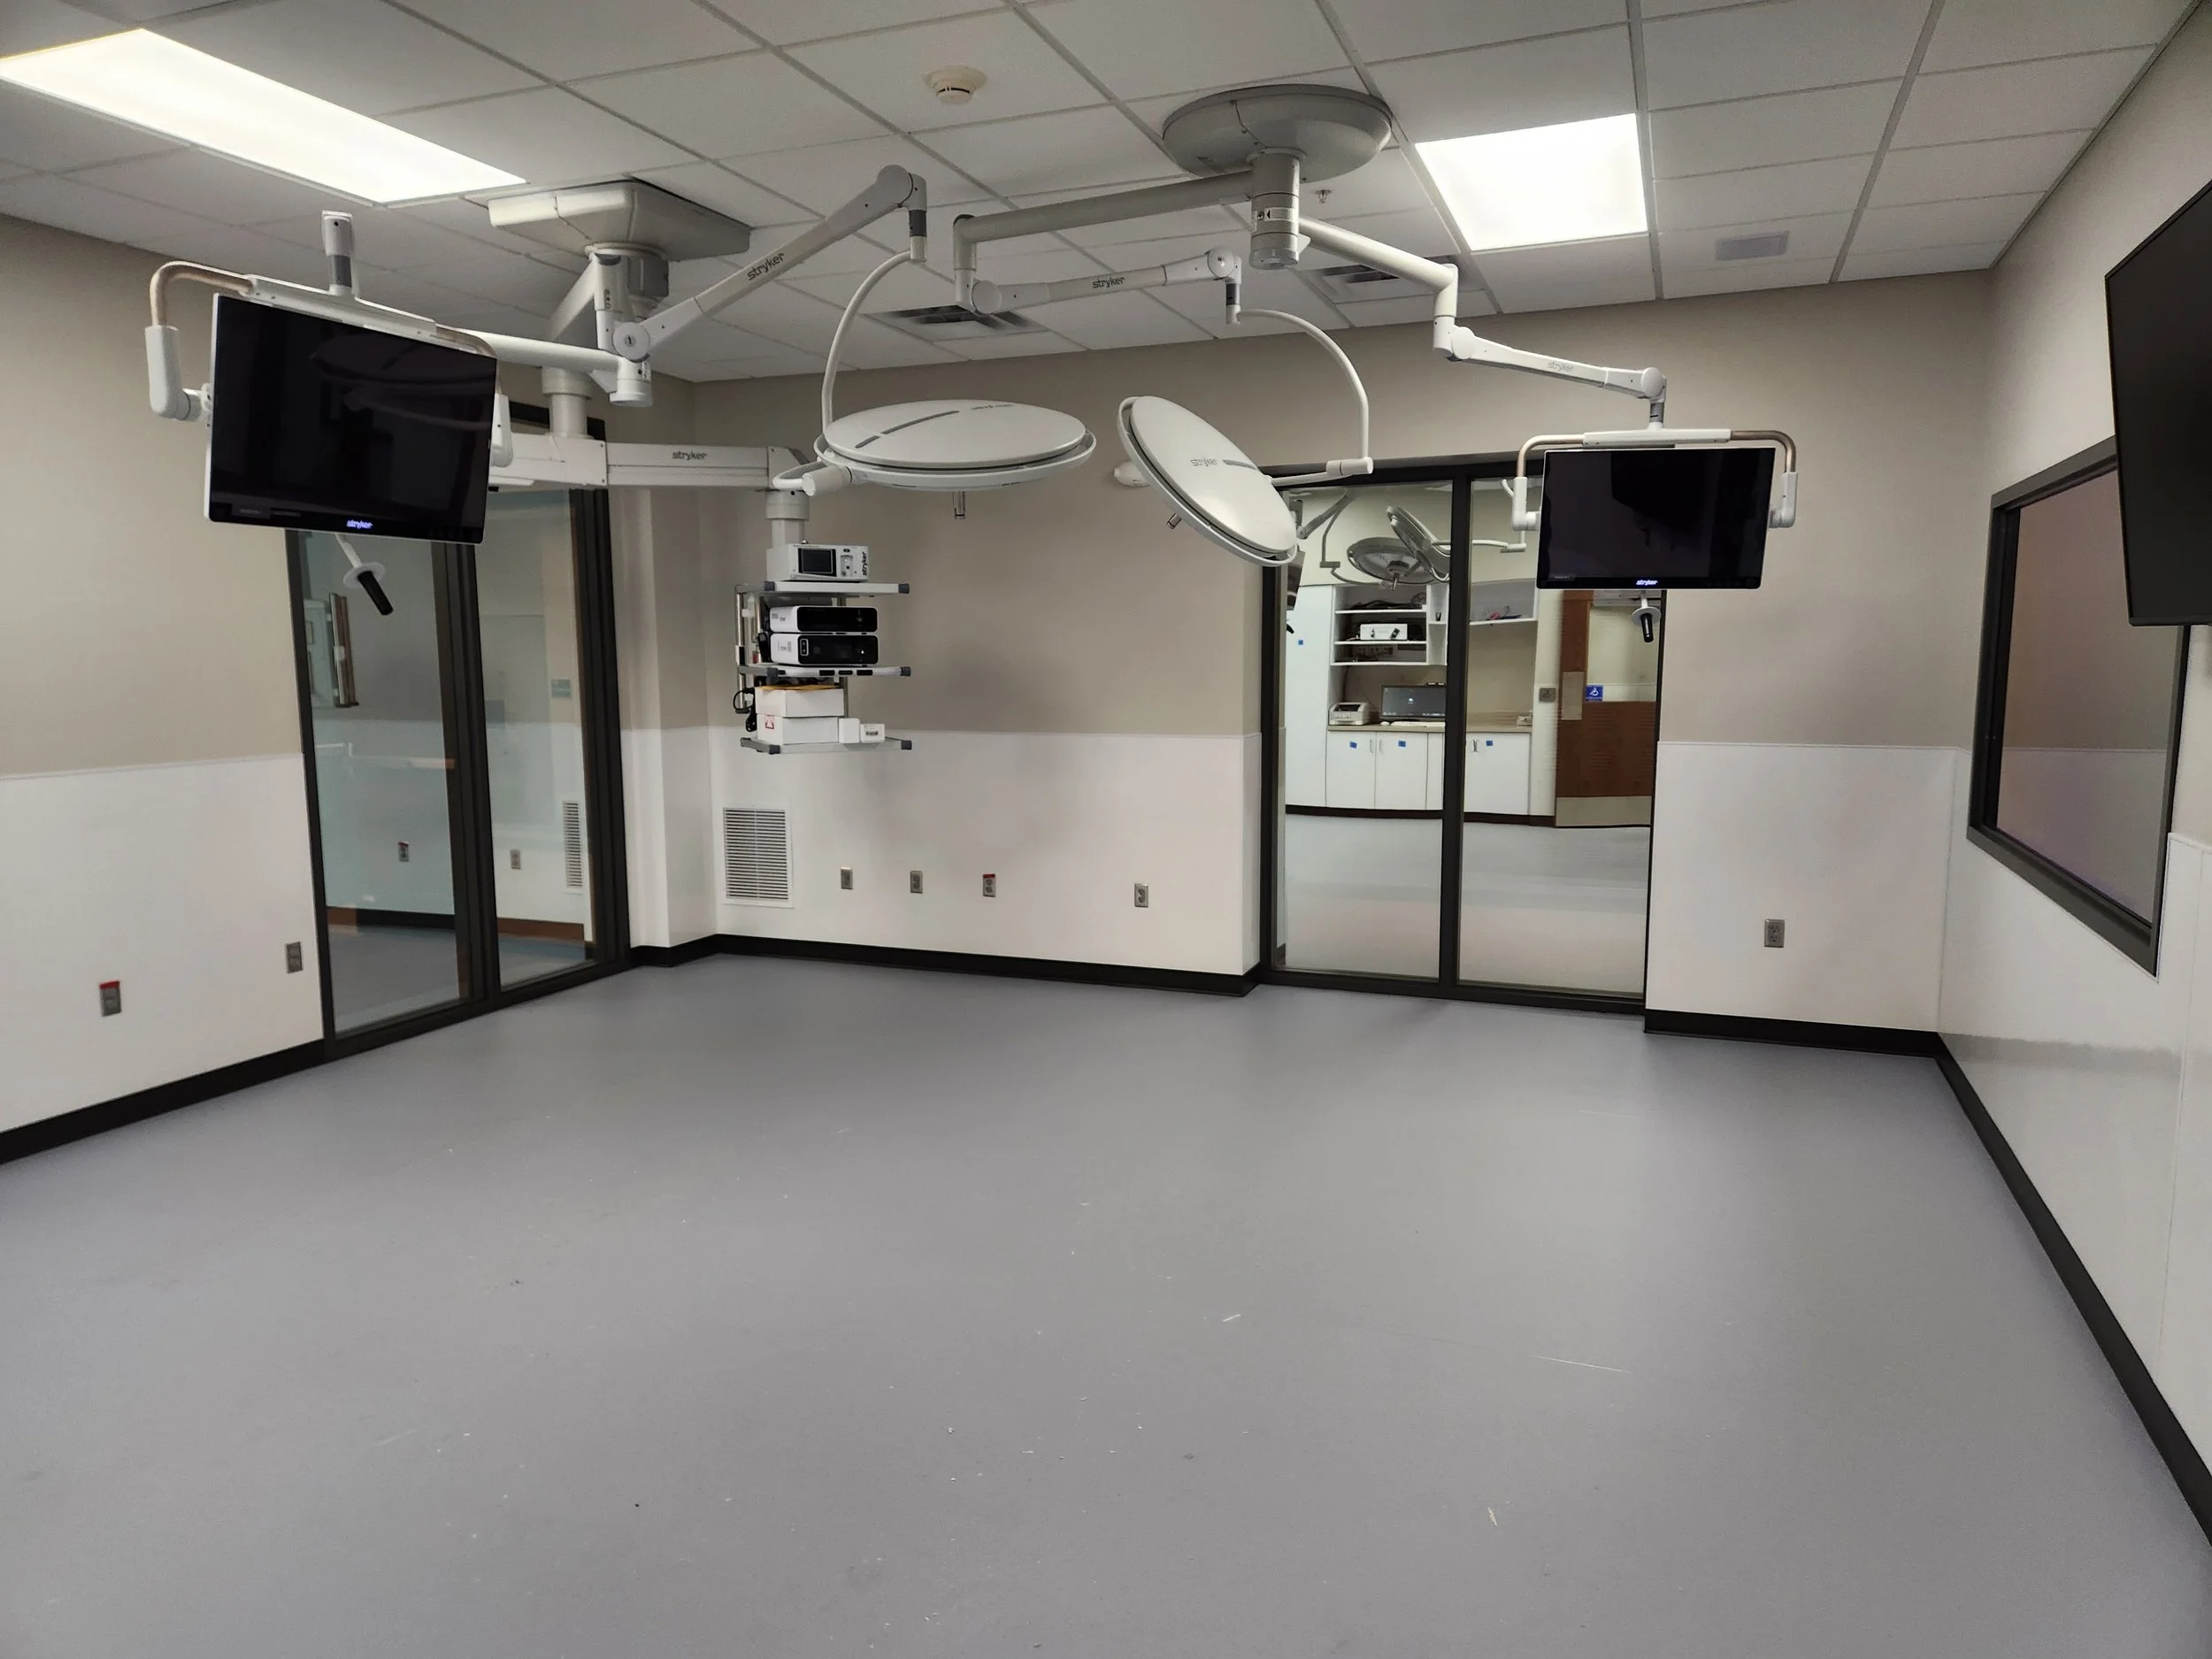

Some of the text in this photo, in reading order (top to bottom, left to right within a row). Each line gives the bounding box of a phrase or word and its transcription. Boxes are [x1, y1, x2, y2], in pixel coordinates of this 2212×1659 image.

[747, 252, 785, 280] stryker
[1092, 276, 1125, 288] stryker
[1548, 361, 1573, 372] stryker
[672, 450, 707, 460] stryker
[347, 519, 373, 529] stryker
